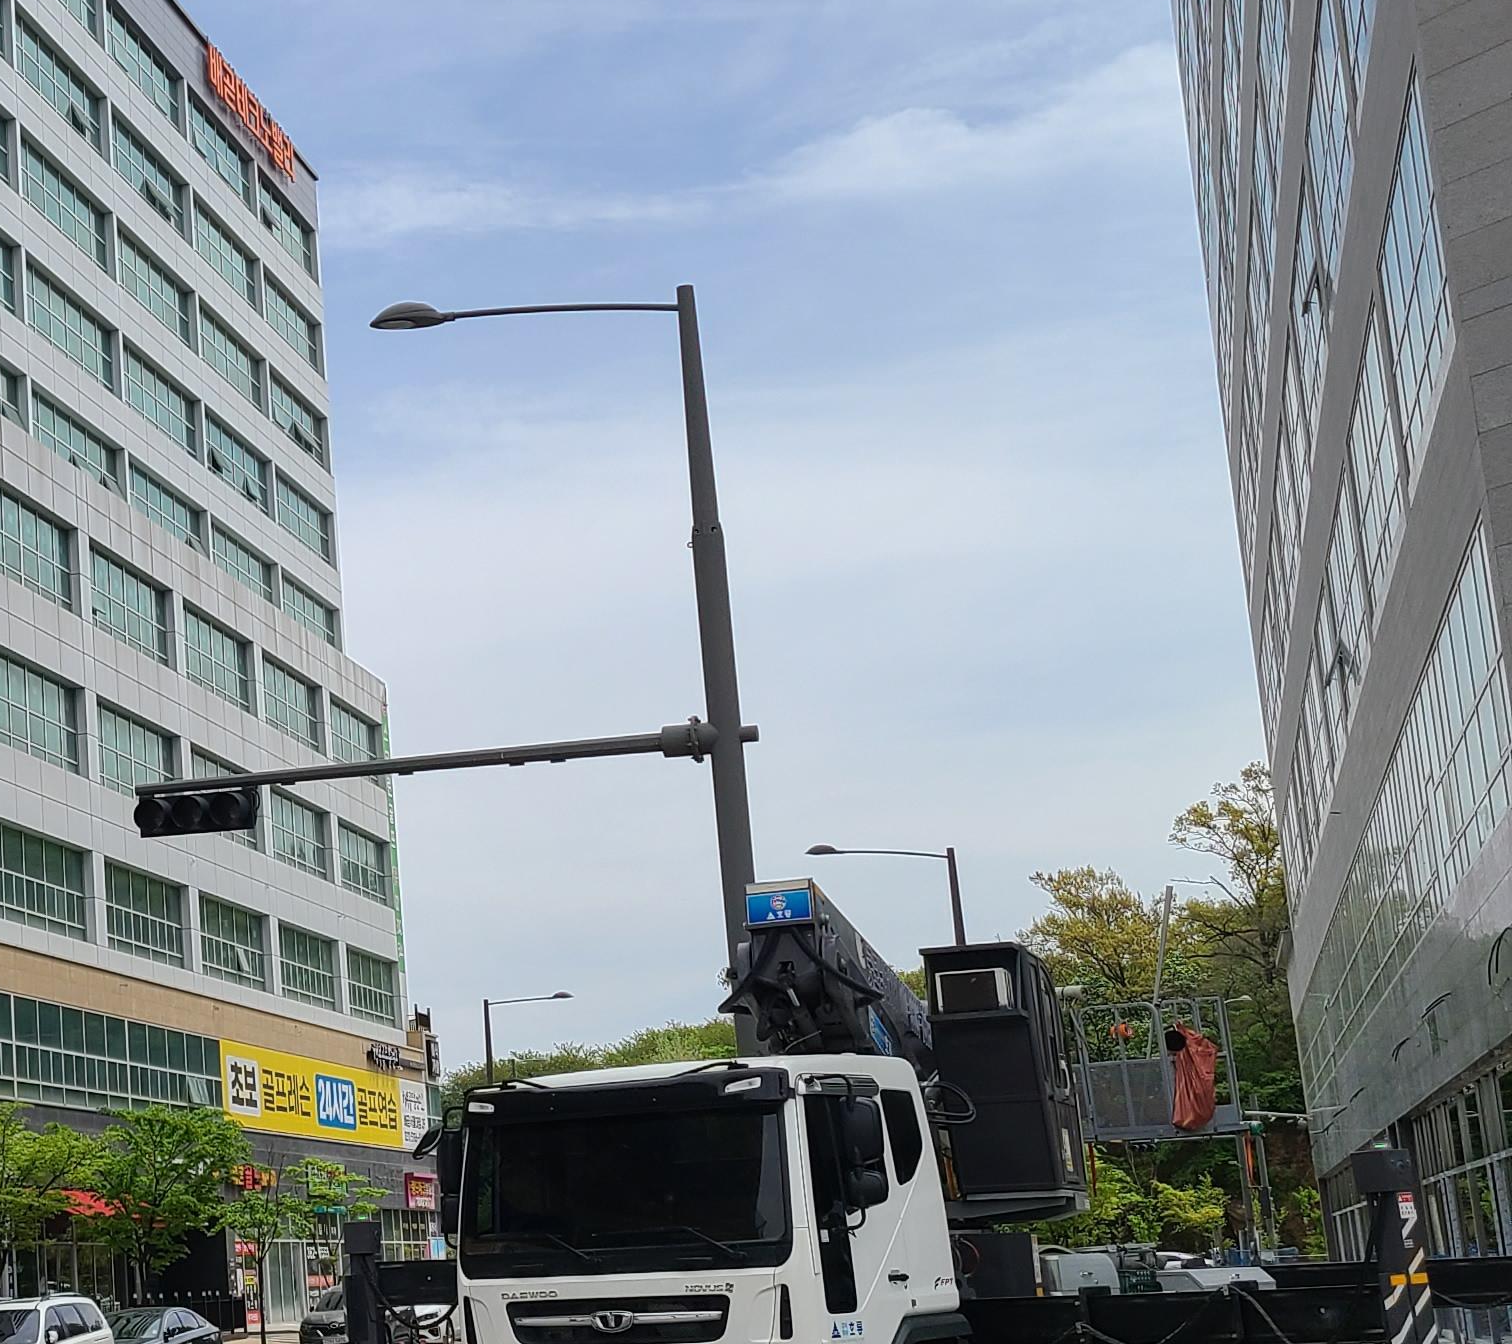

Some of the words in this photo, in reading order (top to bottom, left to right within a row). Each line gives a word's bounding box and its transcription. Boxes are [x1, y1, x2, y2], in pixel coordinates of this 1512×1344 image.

[230, 1061, 258, 1108] 초보
[262, 1068, 311, 1117] 골프레슨
[318, 1078, 355, 1125] 24시간
[357, 1087, 398, 1130] 골프연습
[501, 1291, 558, 1300] DAEWOO
